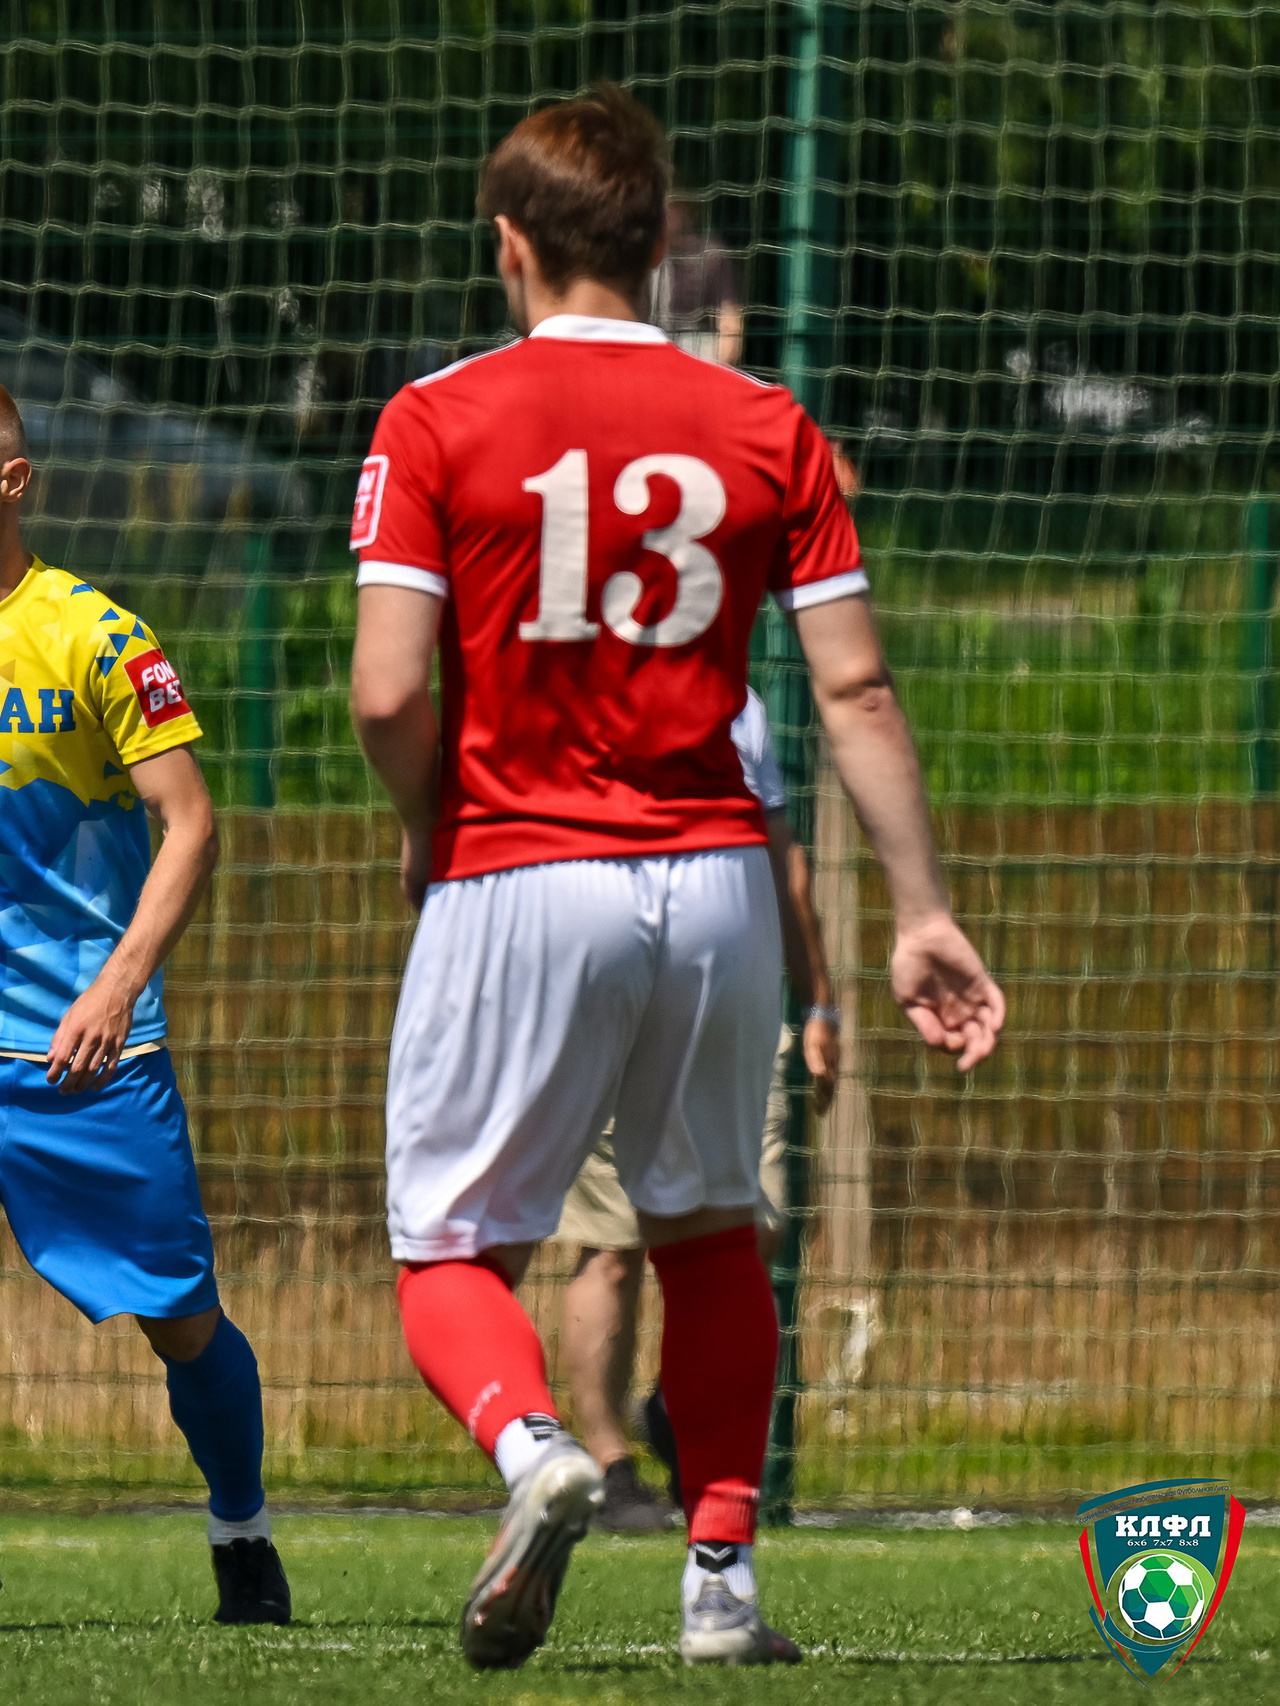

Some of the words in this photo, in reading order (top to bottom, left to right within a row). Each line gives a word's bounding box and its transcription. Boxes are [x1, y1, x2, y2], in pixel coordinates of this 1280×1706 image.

[519, 448, 727, 647] 13
[141, 660, 176, 692] FON
[149, 679, 183, 713] BET
